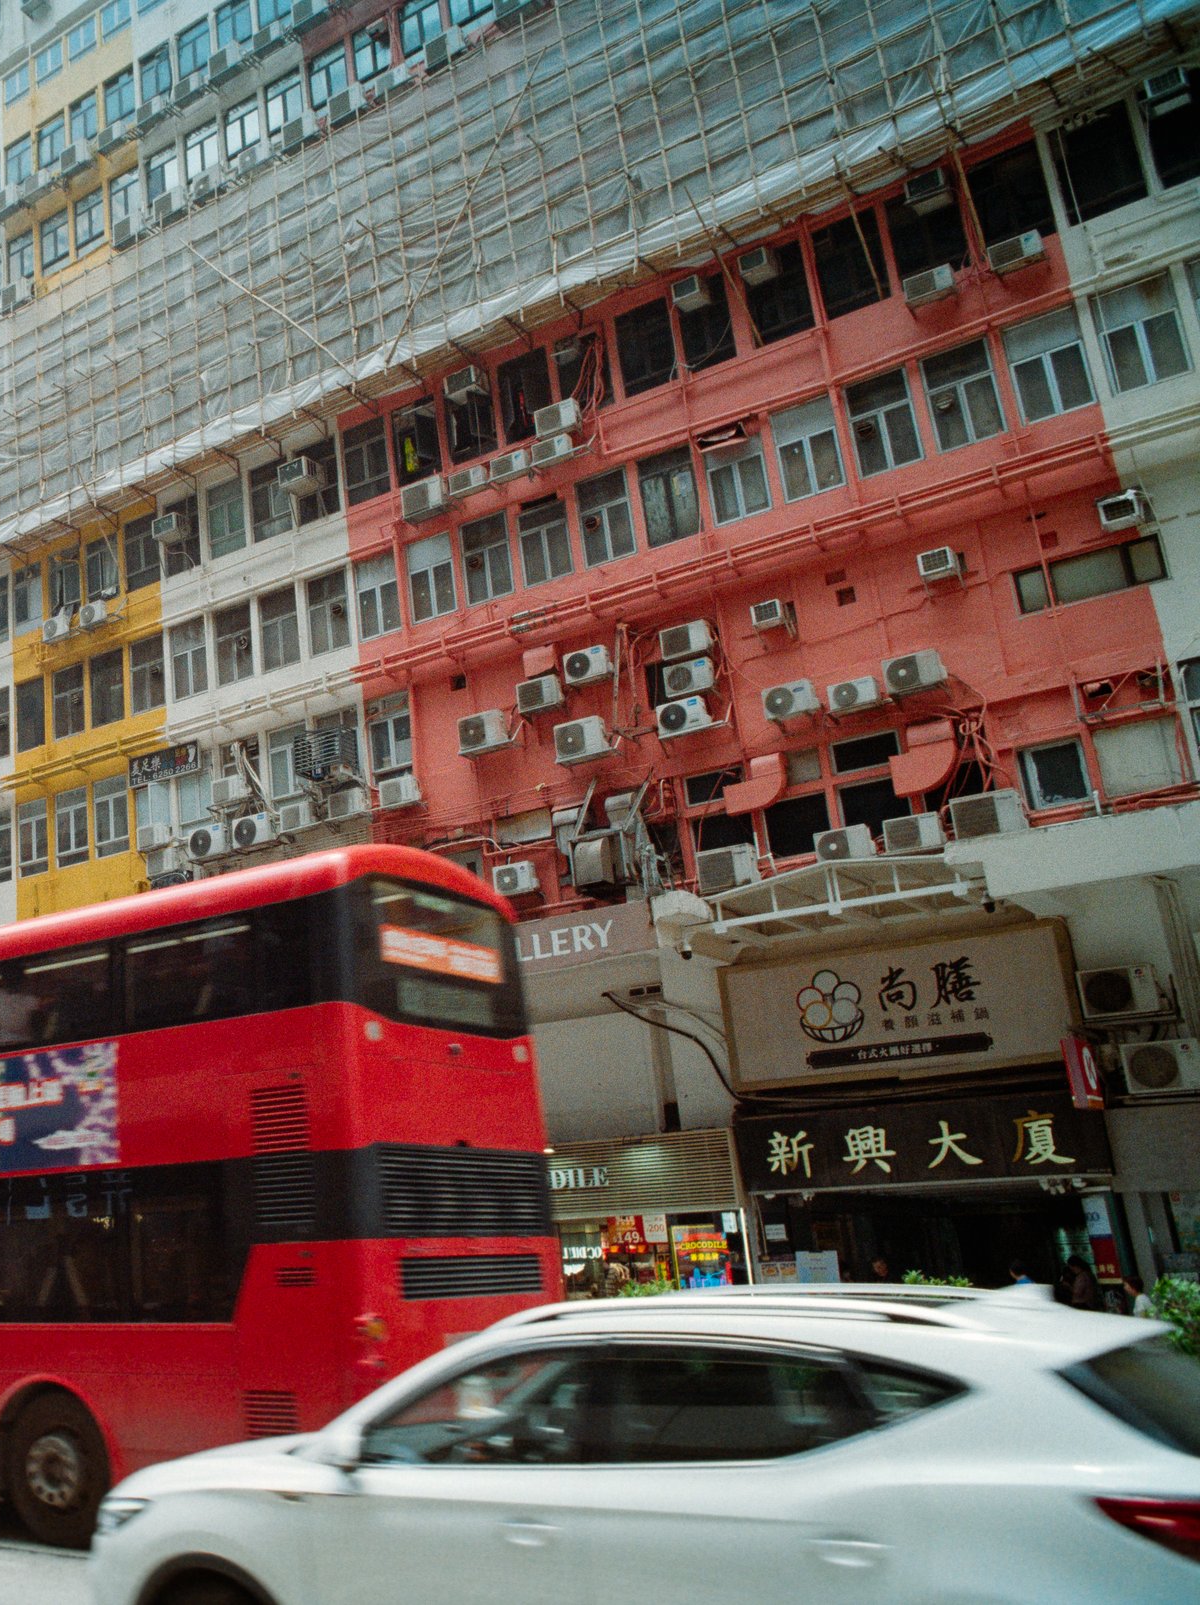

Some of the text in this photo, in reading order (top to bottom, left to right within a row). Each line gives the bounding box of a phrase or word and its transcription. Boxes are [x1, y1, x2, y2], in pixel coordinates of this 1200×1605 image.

[152, 767, 174, 780] 6250
[175, 762, 197, 774] 2266
[514, 919, 613, 962] LLERY
[878, 955, 982, 1012] 尚膳
[766, 1109, 1077, 1179] 新興大廈
[549, 1166, 609, 1190] DILE
[680, 1240, 728, 1251] CROCODILE
